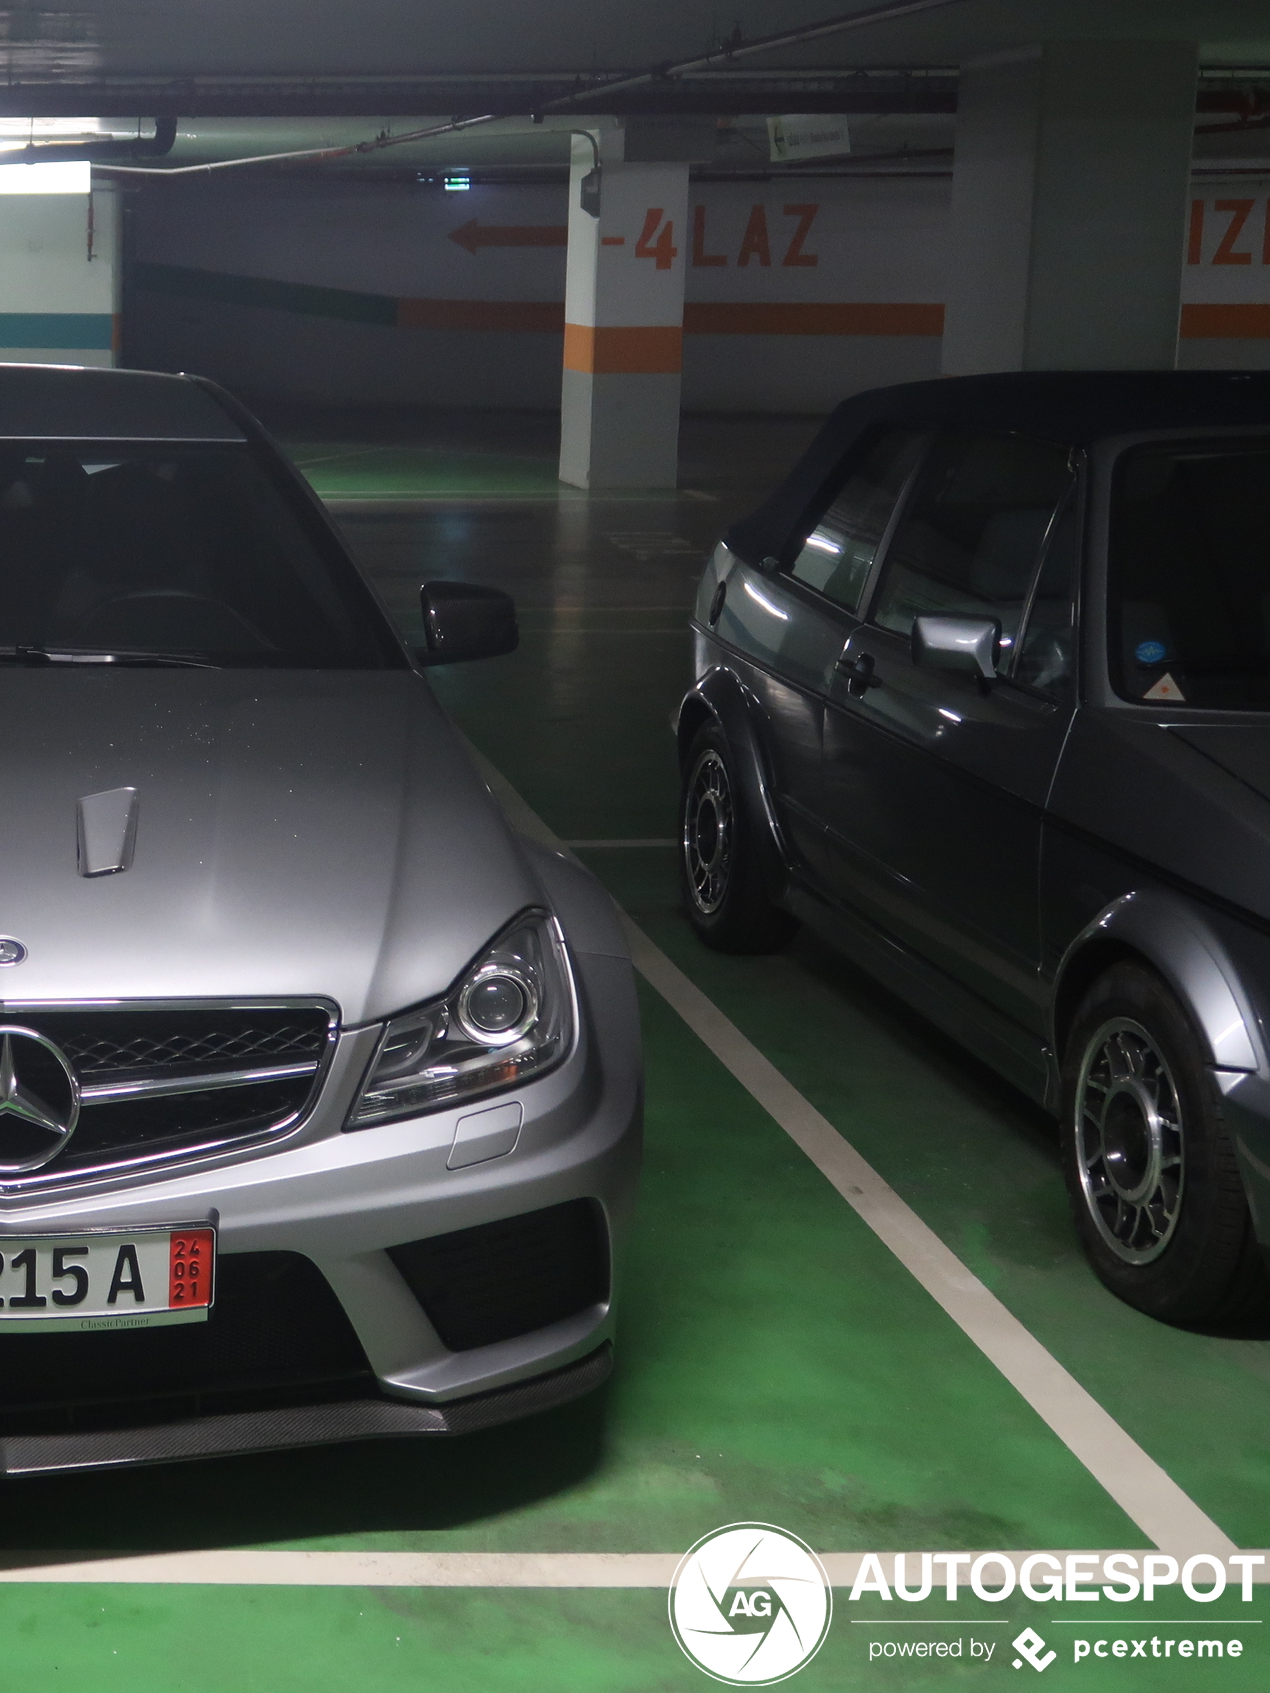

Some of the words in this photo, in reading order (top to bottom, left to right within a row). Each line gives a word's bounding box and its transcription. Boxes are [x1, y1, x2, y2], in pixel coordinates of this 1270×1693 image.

[692, 204, 820, 267] LAZ
[173, 1239, 201, 1259] 24
[106, 1243, 146, 1304] A
[173, 1260, 201, 1280] 06
[173, 1281, 199, 1300] 21
